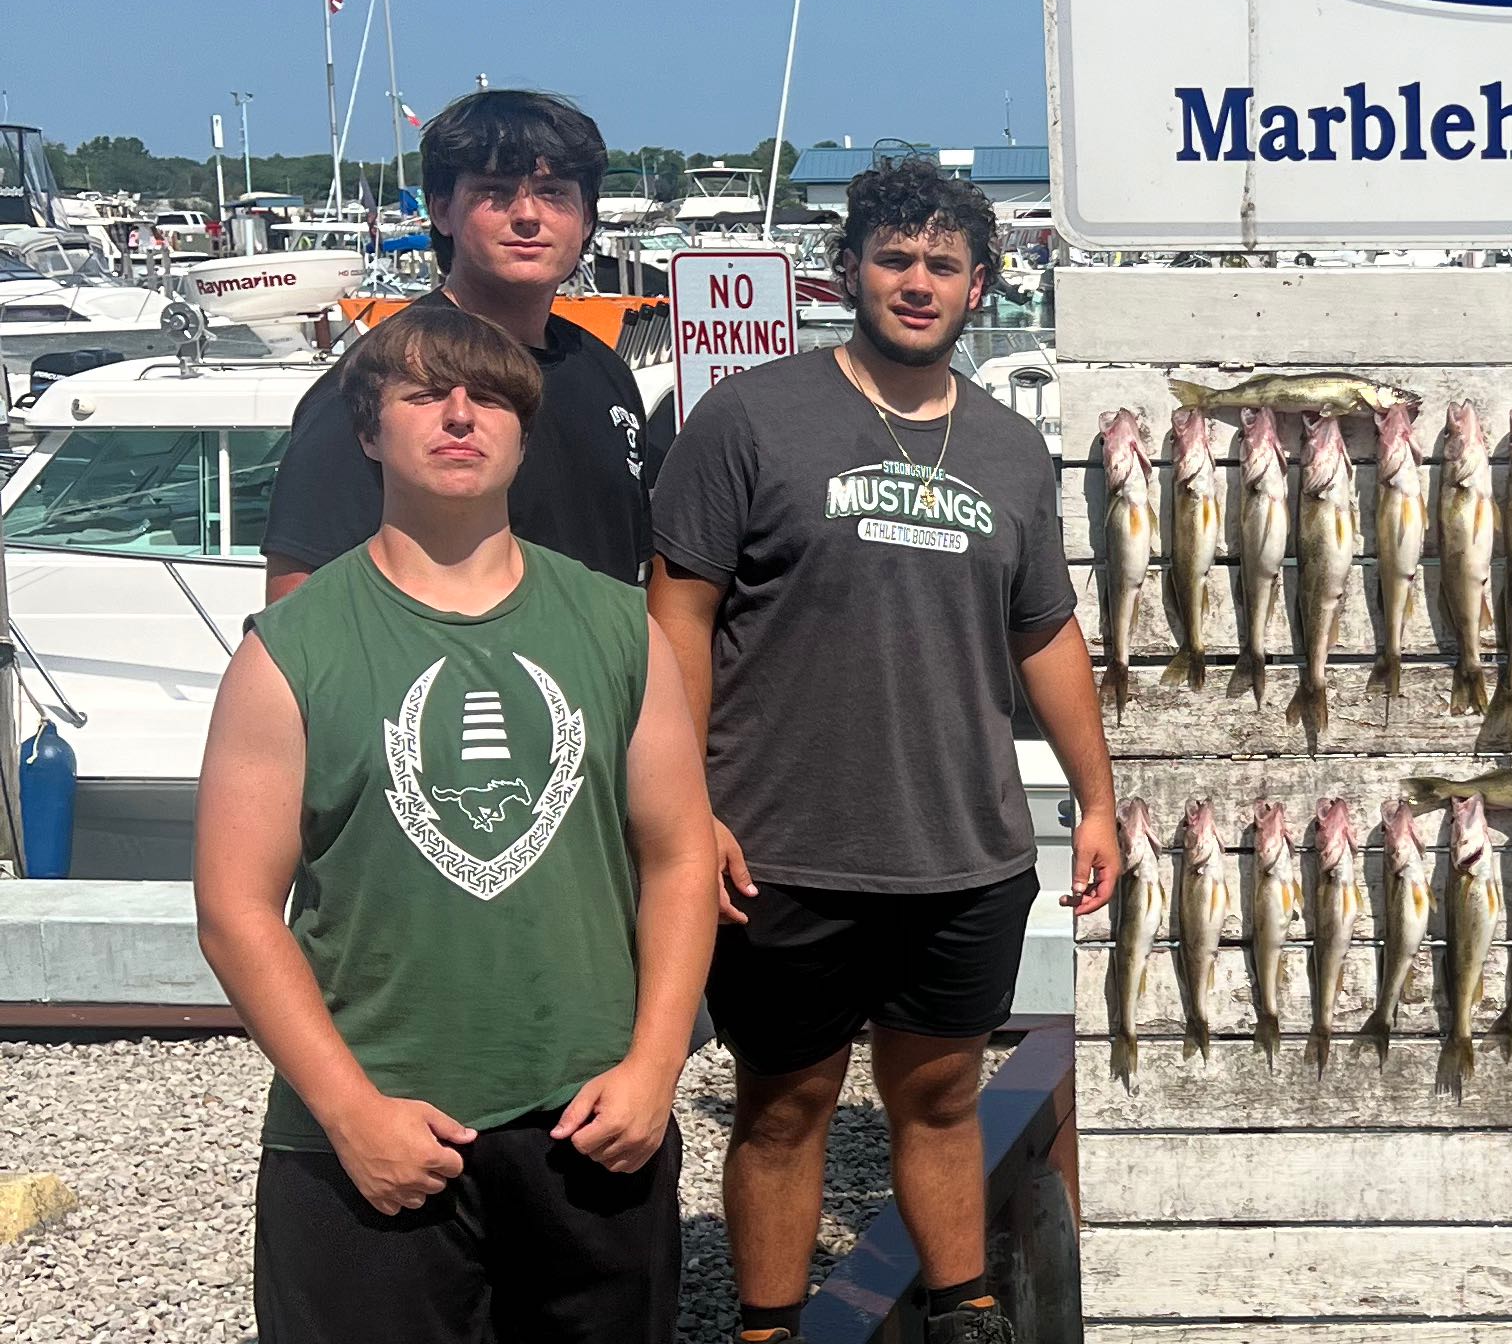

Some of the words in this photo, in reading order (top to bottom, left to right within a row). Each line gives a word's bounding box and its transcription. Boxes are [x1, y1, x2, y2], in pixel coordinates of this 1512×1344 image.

[196, 271, 297, 297] Raymarine
[709, 274, 753, 309] NO
[681, 320, 787, 356] PARKING
[827, 476, 994, 535] MUSTANGS
[865, 521, 911, 543] ATHLETIC
[912, 527, 962, 550] BOOSTERS
